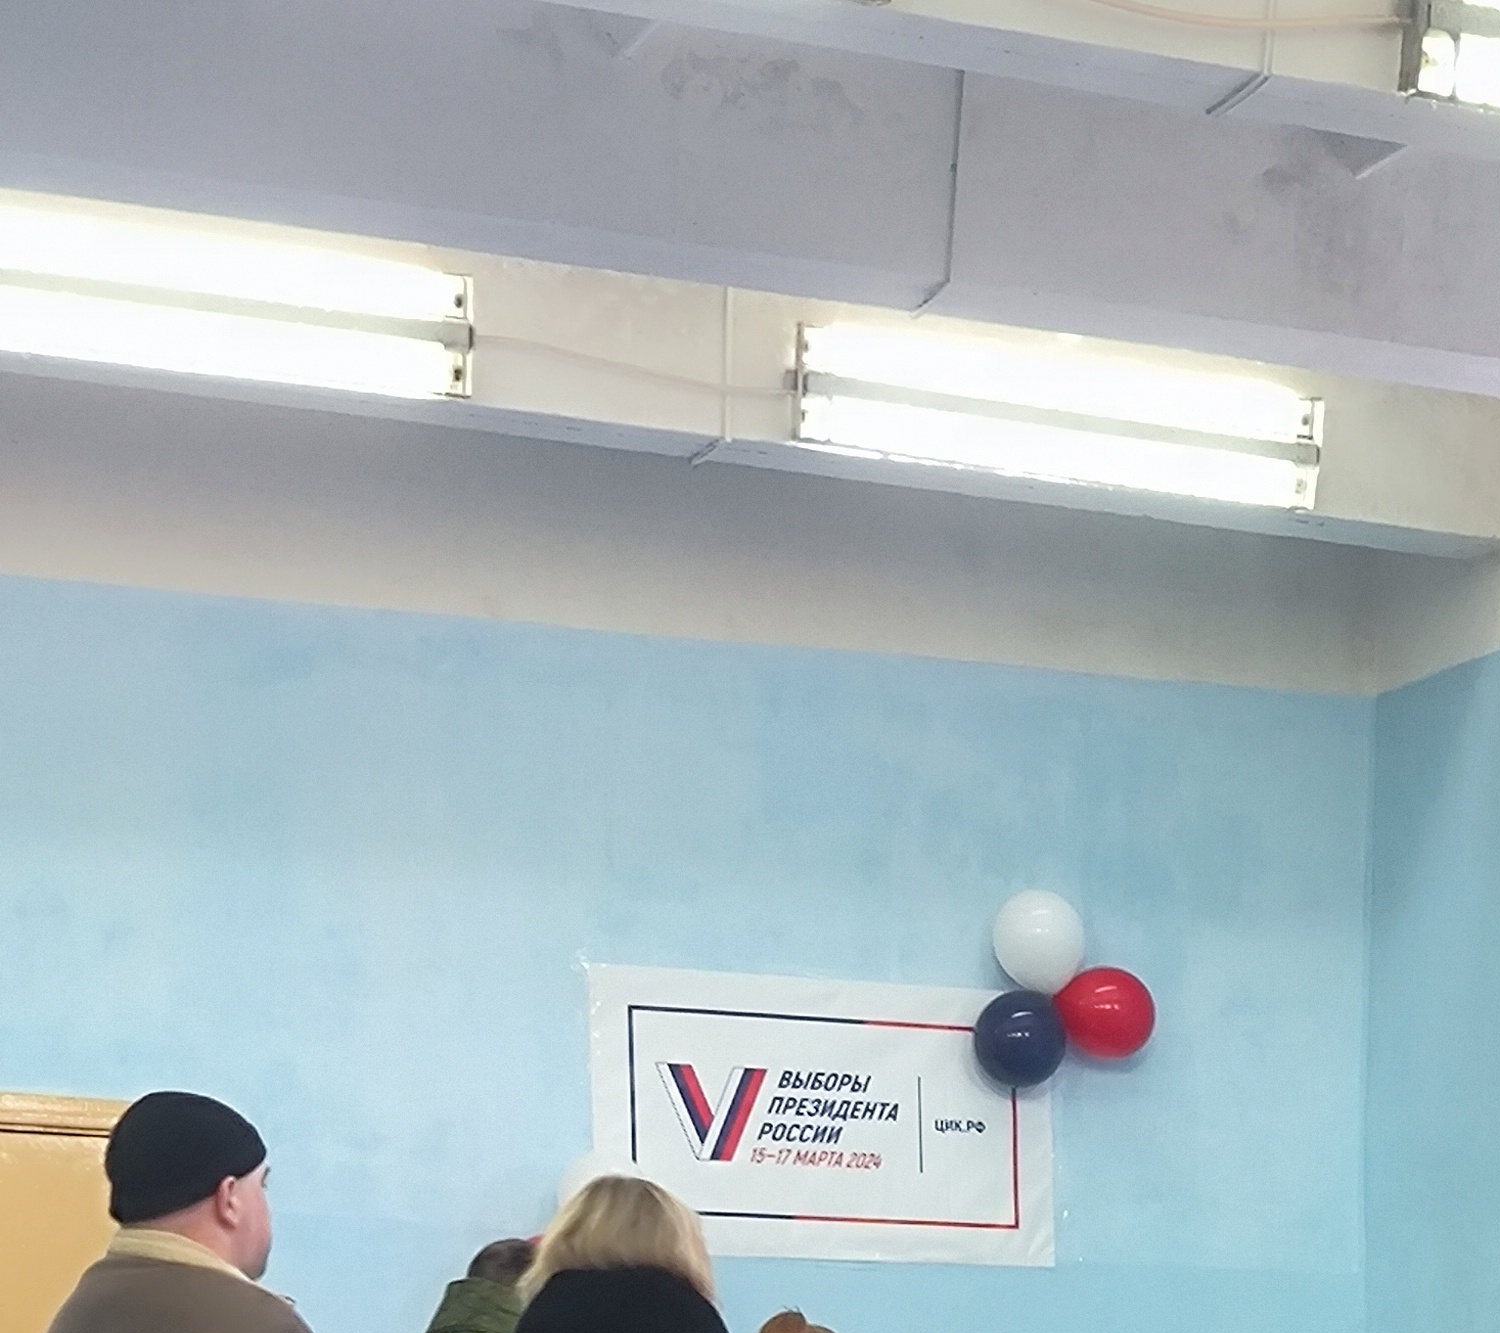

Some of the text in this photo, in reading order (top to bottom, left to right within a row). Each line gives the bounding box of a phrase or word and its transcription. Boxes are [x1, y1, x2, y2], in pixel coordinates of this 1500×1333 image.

[777, 1070, 872, 1093] ВЫБОРЫ
[767, 1096, 899, 1121] ПРЕЗИДЕНТА
[757, 1122, 844, 1144] РОССИИ
[935, 1119, 986, 1133] ЦИК.РФ
[793, 1150, 844, 1168] МАРТА
[846, 1152, 882, 1170] 2024
